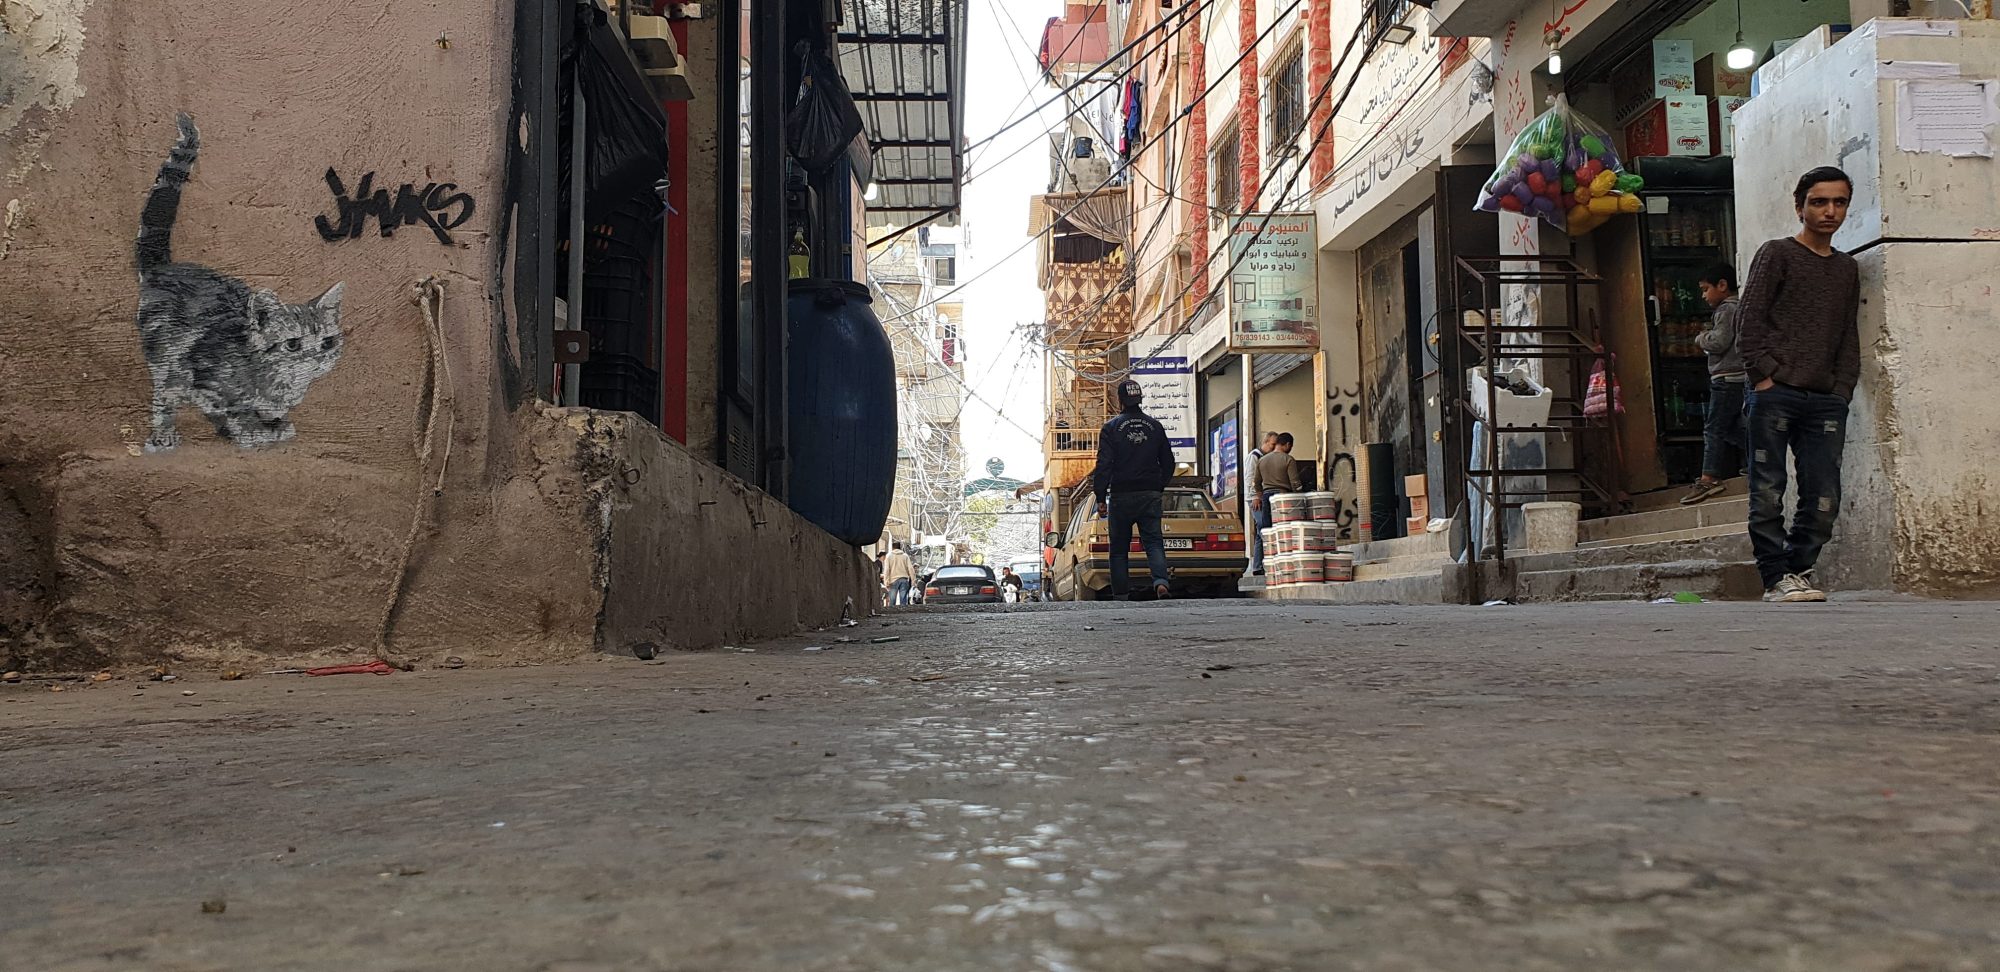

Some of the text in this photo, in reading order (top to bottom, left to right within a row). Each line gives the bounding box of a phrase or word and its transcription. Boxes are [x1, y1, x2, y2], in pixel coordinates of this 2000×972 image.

[1333, 153, 1377, 228] القاسم
[1148, 344, 1174, 352] الدتور
[1164, 539, 1187, 548] 42639
